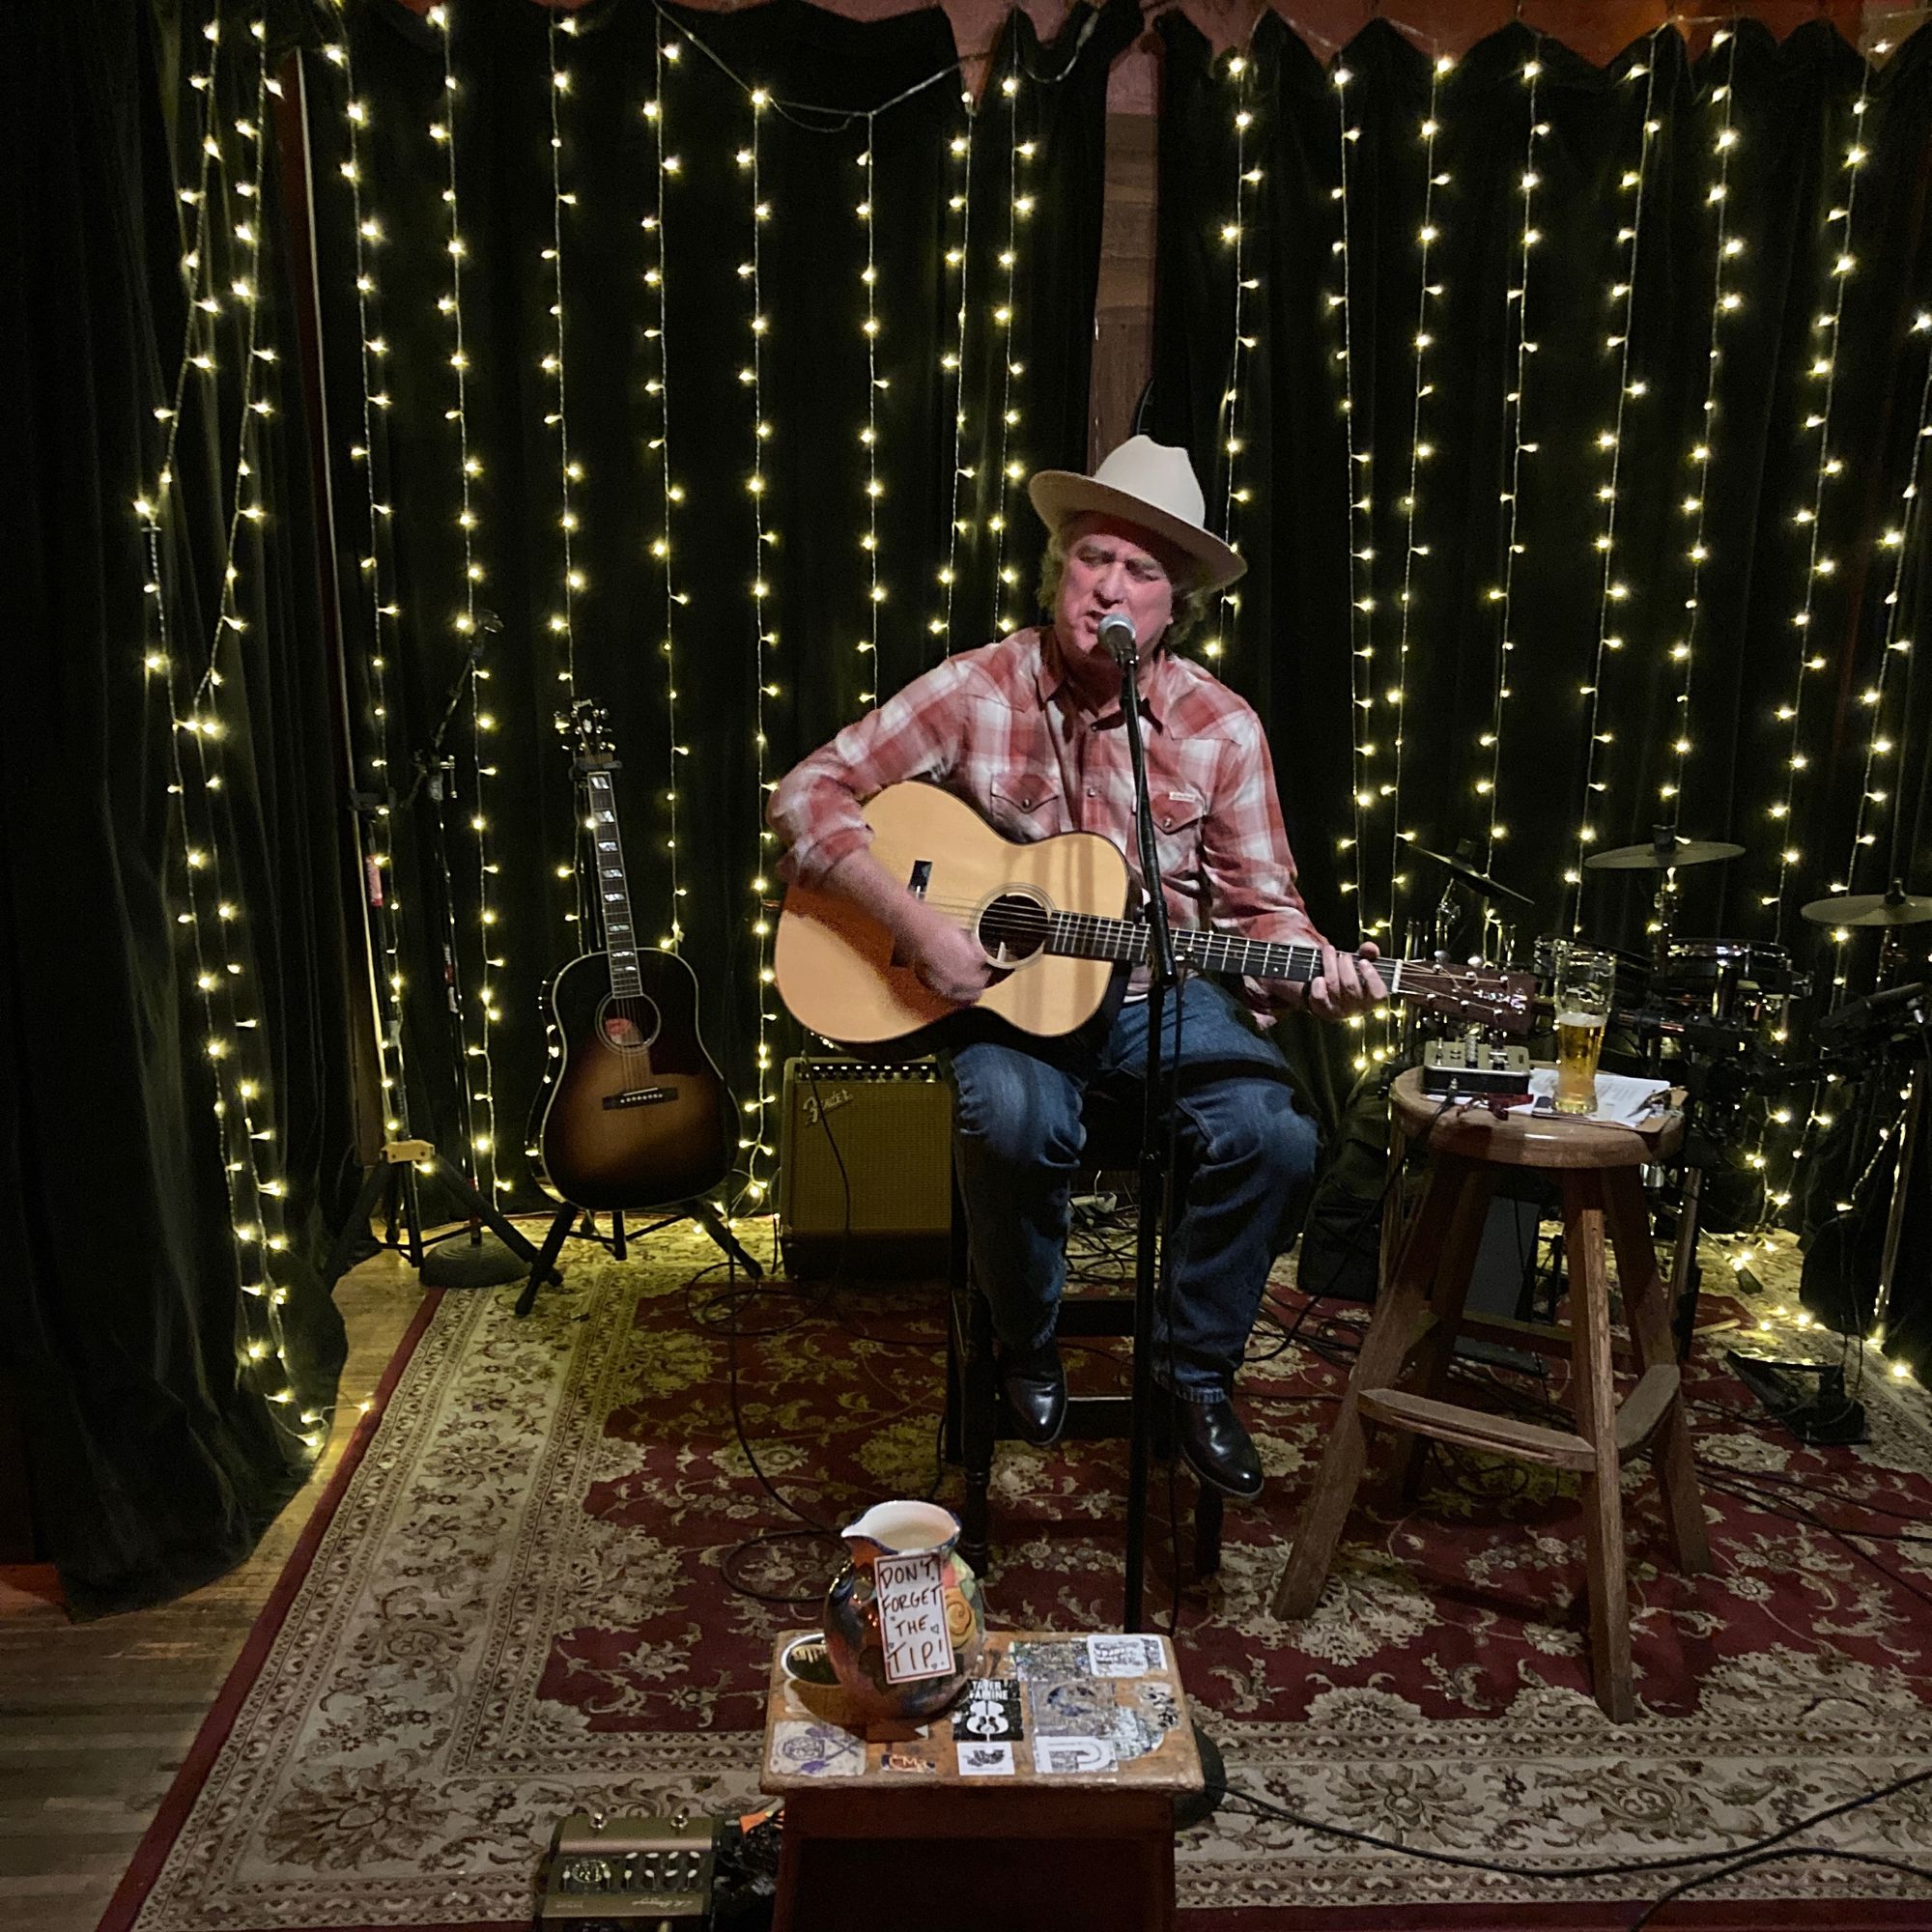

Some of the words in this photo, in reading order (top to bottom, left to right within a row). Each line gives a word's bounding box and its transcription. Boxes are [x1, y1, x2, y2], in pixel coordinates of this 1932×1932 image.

[803, 1089, 854, 1126] Fnder
[879, 1556, 937, 1589] DON'T
[882, 1583, 943, 1617] FORGET
[895, 1614, 929, 1637] THE
[887, 1639, 945, 1673] TIP!
